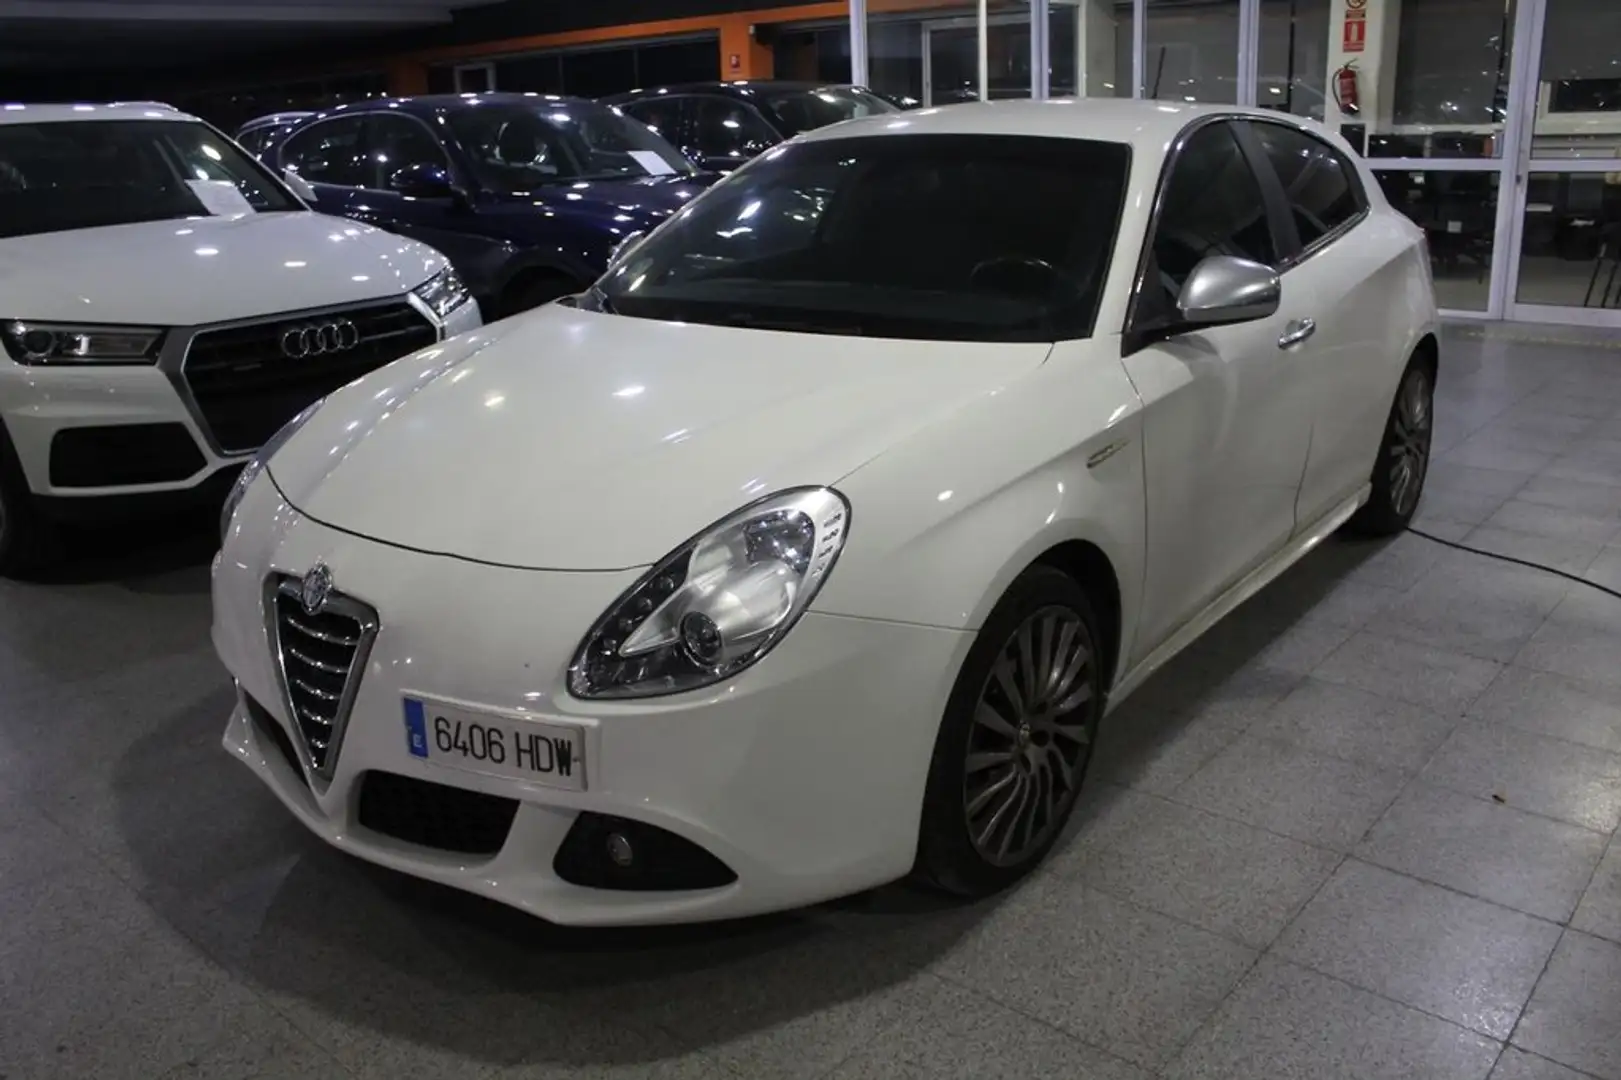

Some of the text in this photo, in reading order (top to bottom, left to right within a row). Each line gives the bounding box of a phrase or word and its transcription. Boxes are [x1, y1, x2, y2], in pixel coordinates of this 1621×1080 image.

[412, 734, 423, 748] E
[434, 716, 572, 777] 6406 HDW
